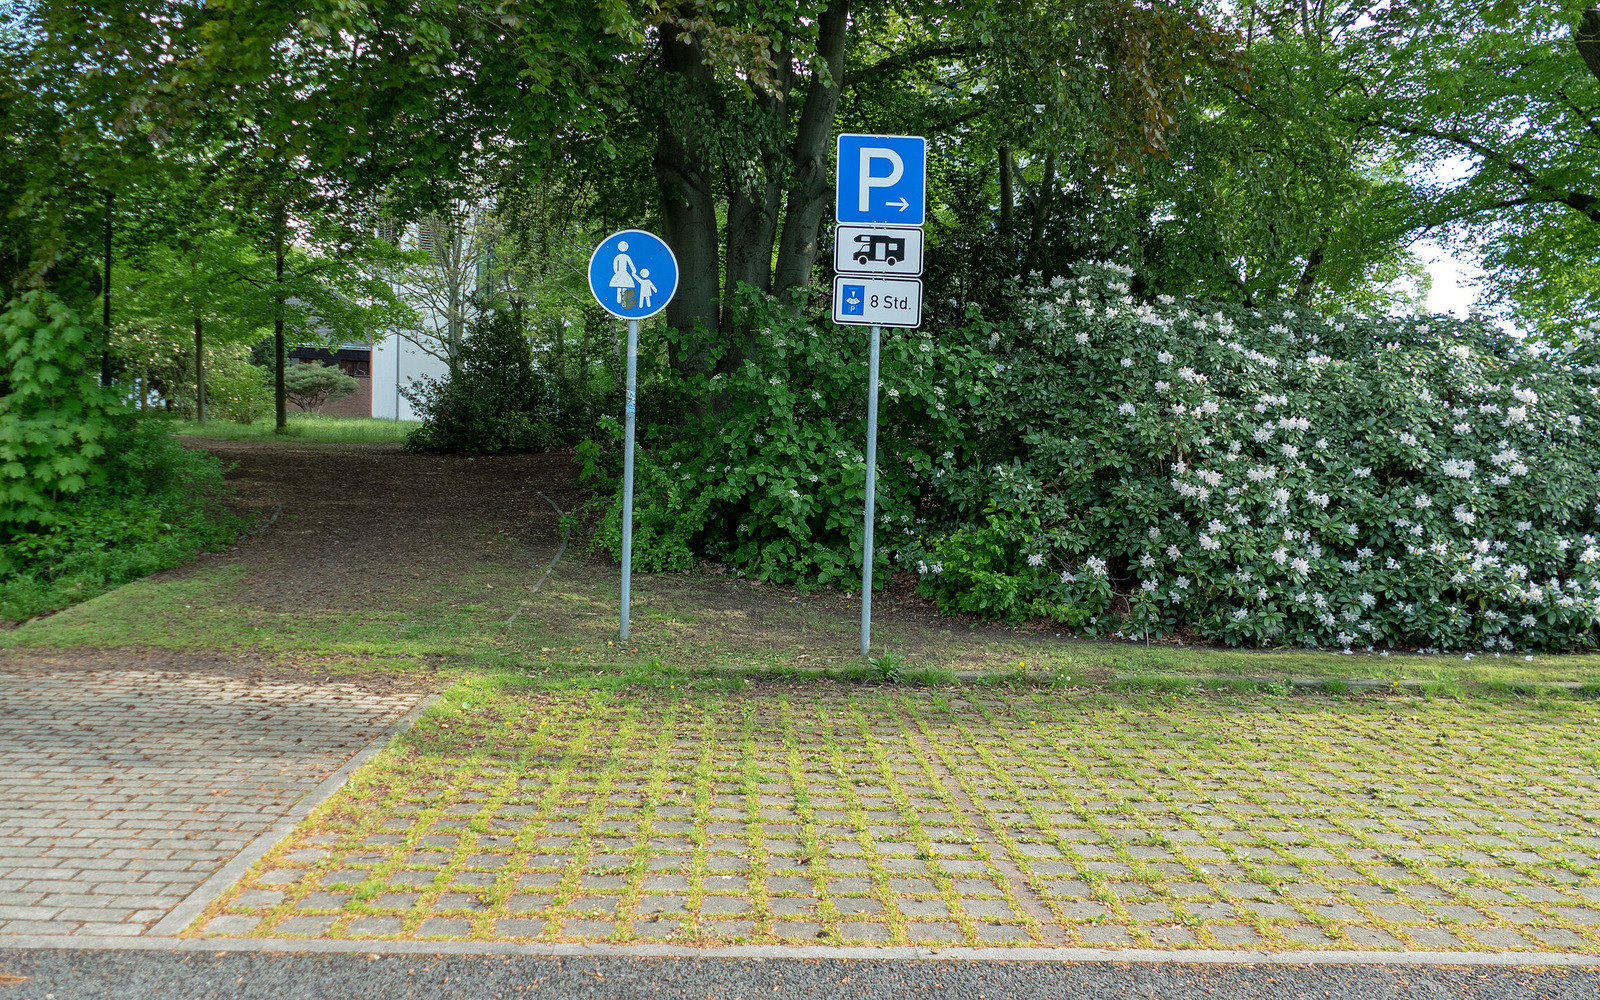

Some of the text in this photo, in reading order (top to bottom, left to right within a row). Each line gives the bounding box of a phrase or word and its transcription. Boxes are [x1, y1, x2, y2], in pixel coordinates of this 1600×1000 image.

[858, 147, 904, 212] P
[870, 294, 911, 310] 8 Std.
